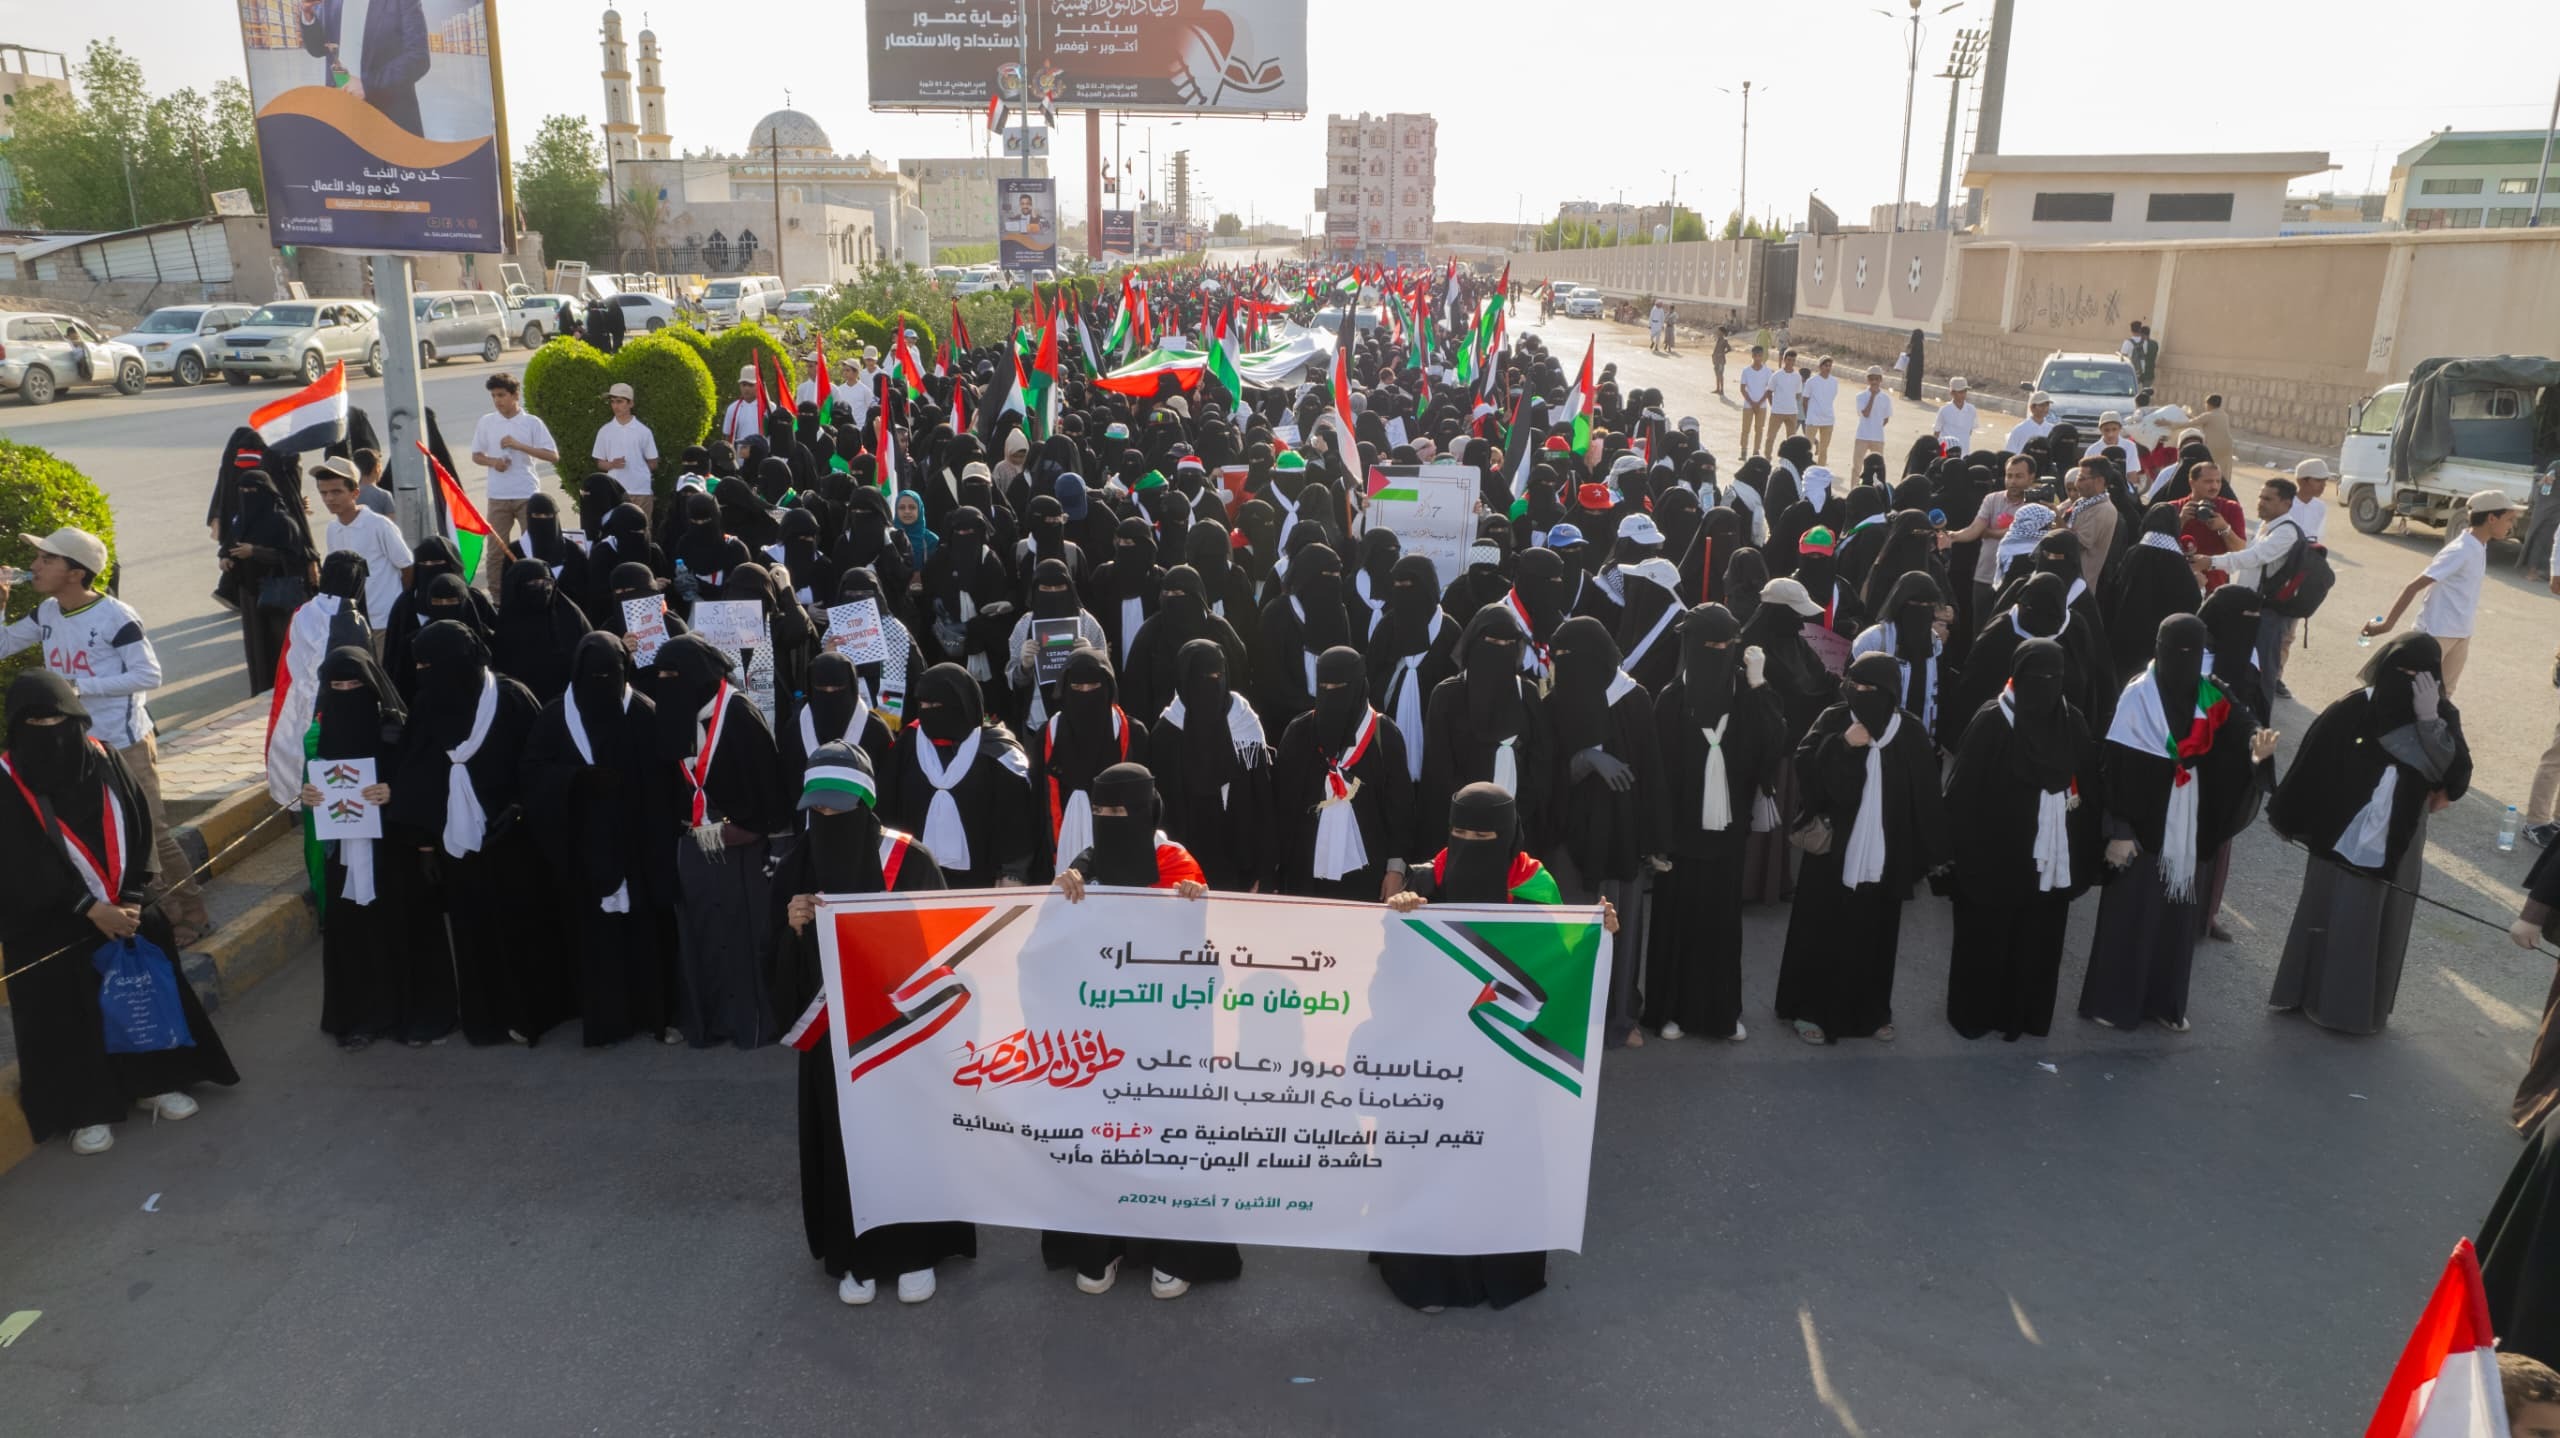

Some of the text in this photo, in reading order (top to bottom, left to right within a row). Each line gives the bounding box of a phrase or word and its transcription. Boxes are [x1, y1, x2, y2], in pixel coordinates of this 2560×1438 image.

[913, 11, 967, 26] عصور
[1054, 20, 1137, 37] سبتمبر
[885, 32, 961, 50] والاستعمار
[1054, 40, 1089, 54] نوفمبر
[1099, 40, 1137, 54] أكتوبر
[363, 167, 440, 182] كن من النخبة
[311, 179, 400, 195] كن مع رواد الأعمال
[847, 617, 864, 629] STOP
[50, 646, 96, 677] AIA
[1099, 939, 1336, 972] «تحت شعار»
[1079, 976, 1351, 1015] (طوفان من أجل التحرير)
[1049, 1028, 1126, 1089] طوفان
[1136, 1049, 1192, 1071] على
[1289, 1059, 1346, 1079] مرور
[1353, 1054, 1464, 1083] بمناسبة
[1103, 1082, 1228, 1105] الفلسطيني
[1234, 1085, 1315, 1105] الشعب
[1320, 1089, 1352, 1109] مع
[952, 1113, 1485, 1149] تقيم لجنة الفعاليات التضامنية مع «غزة» مسيرة نسائية
[1049, 1144, 1093, 1164] مأرب
[1256, 1152, 1311, 1168] لنساء
[1317, 1151, 1383, 1168] حاشدة
[1118, 1193, 1167, 1205] 2024م
[1172, 1194, 1216, 1209] أكتوبر
[1222, 1198, 1230, 1207] 7
[1285, 1199, 1313, 1211] يوم
